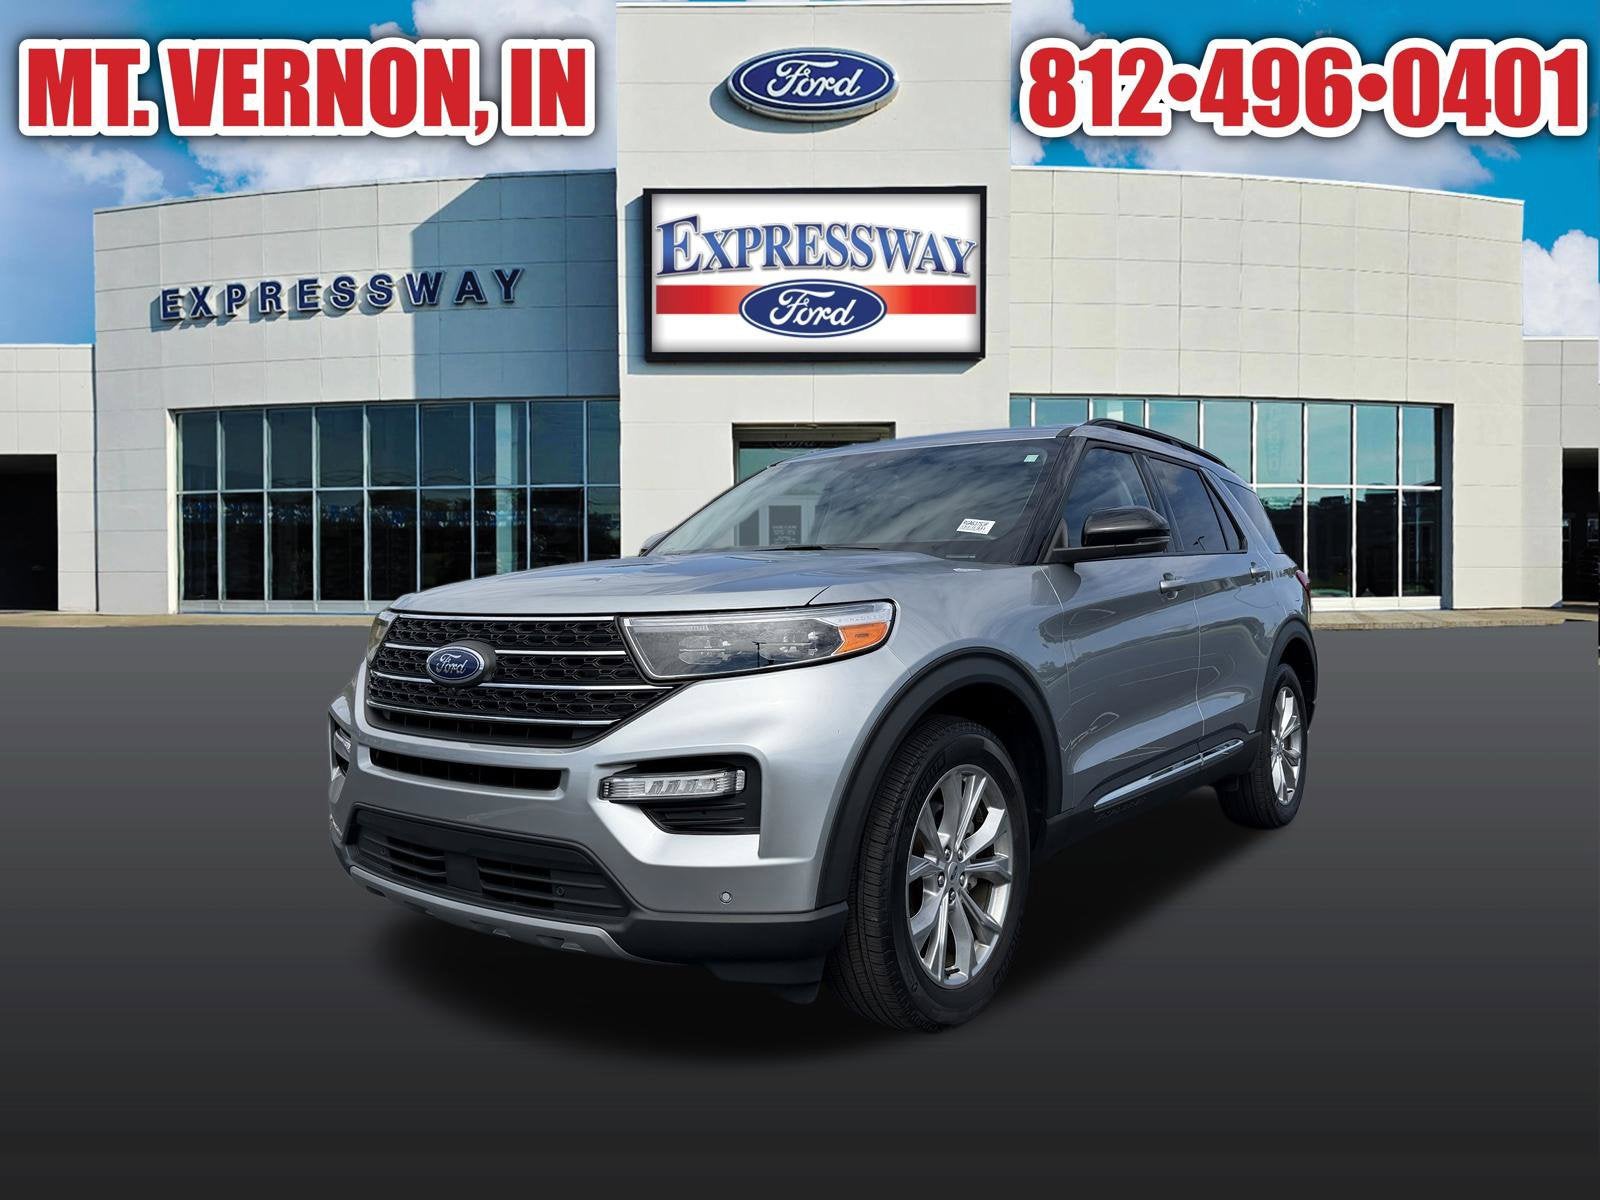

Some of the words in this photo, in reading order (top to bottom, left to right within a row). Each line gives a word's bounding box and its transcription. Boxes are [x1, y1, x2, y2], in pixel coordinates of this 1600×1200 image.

[766, 59, 864, 97] Ford
[656, 213, 977, 277] EXPRESSWAY
[158, 267, 527, 321] EXPRESSWAY
[768, 288, 858, 327] Ford
[436, 653, 469, 674] Ford
